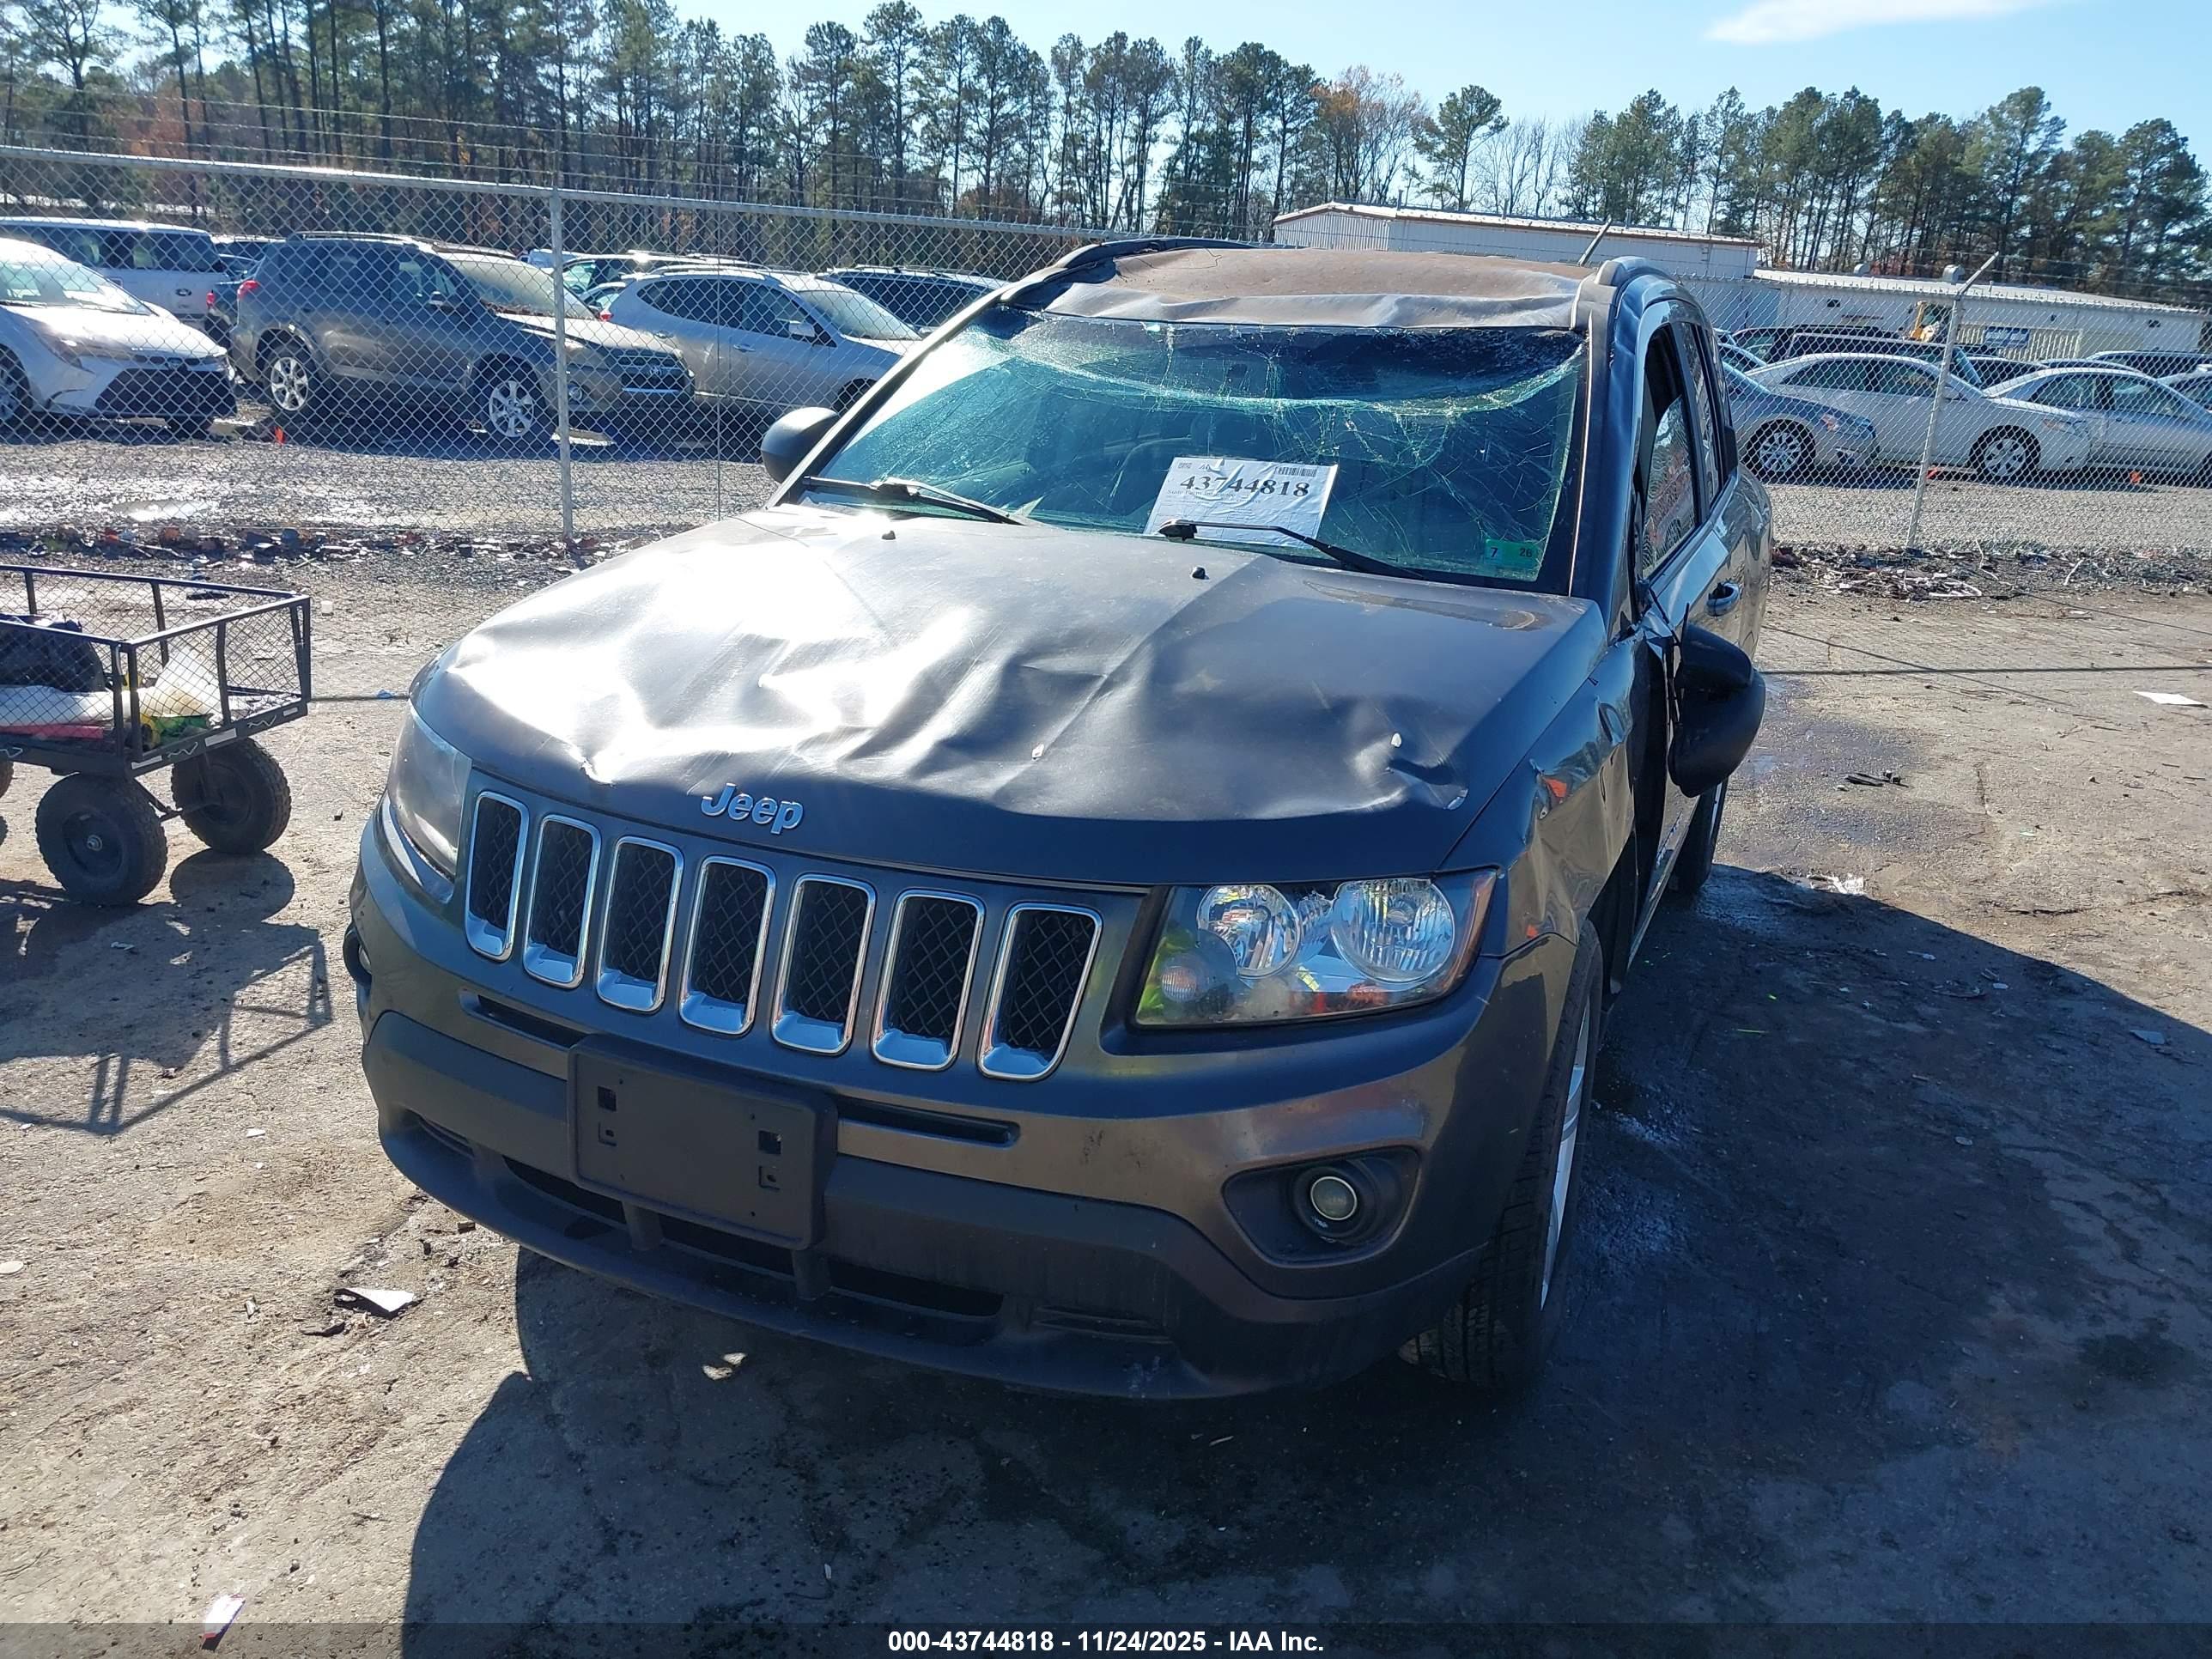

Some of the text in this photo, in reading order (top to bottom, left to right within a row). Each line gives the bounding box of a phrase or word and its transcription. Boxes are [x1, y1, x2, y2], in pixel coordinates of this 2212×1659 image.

[1180, 475, 1310, 497] 43744818
[1490, 546, 1498, 558] 7
[701, 782, 804, 835] Jeep
